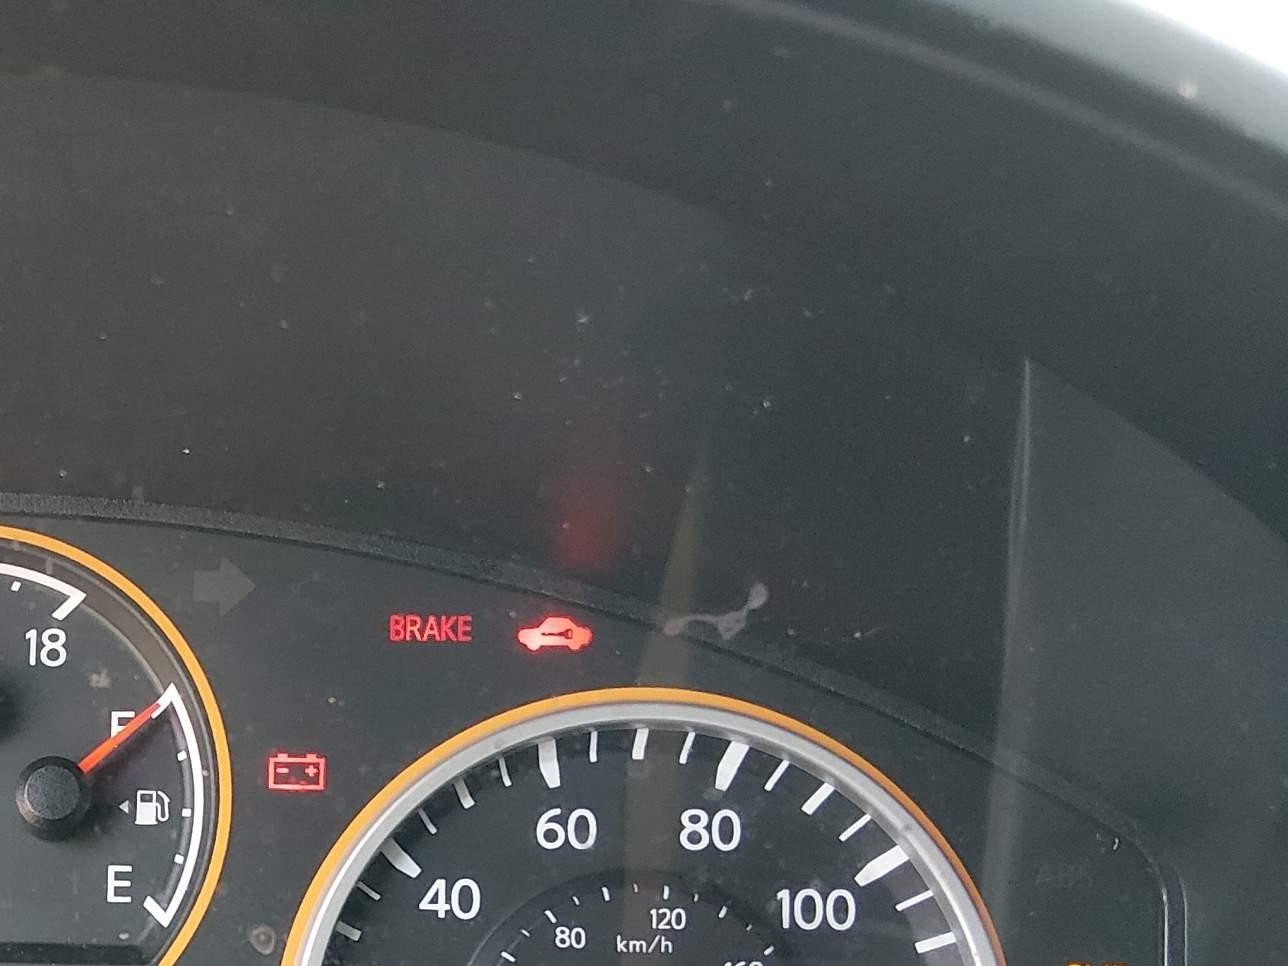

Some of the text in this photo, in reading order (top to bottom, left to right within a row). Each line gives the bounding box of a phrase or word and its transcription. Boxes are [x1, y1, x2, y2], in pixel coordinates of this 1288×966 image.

[390, 614, 472, 641] BRAKE
[25, 628, 67, 667] 18
[536, 808, 597, 849] 60
[679, 809, 741, 851] 80
[107, 865, 132, 903] E
[418, 878, 481, 920] 40
[650, 908, 686, 930] 120
[777, 889, 856, 931] 100
[555, 927, 586, 949] 80
[616, 935, 673, 954] km/h
